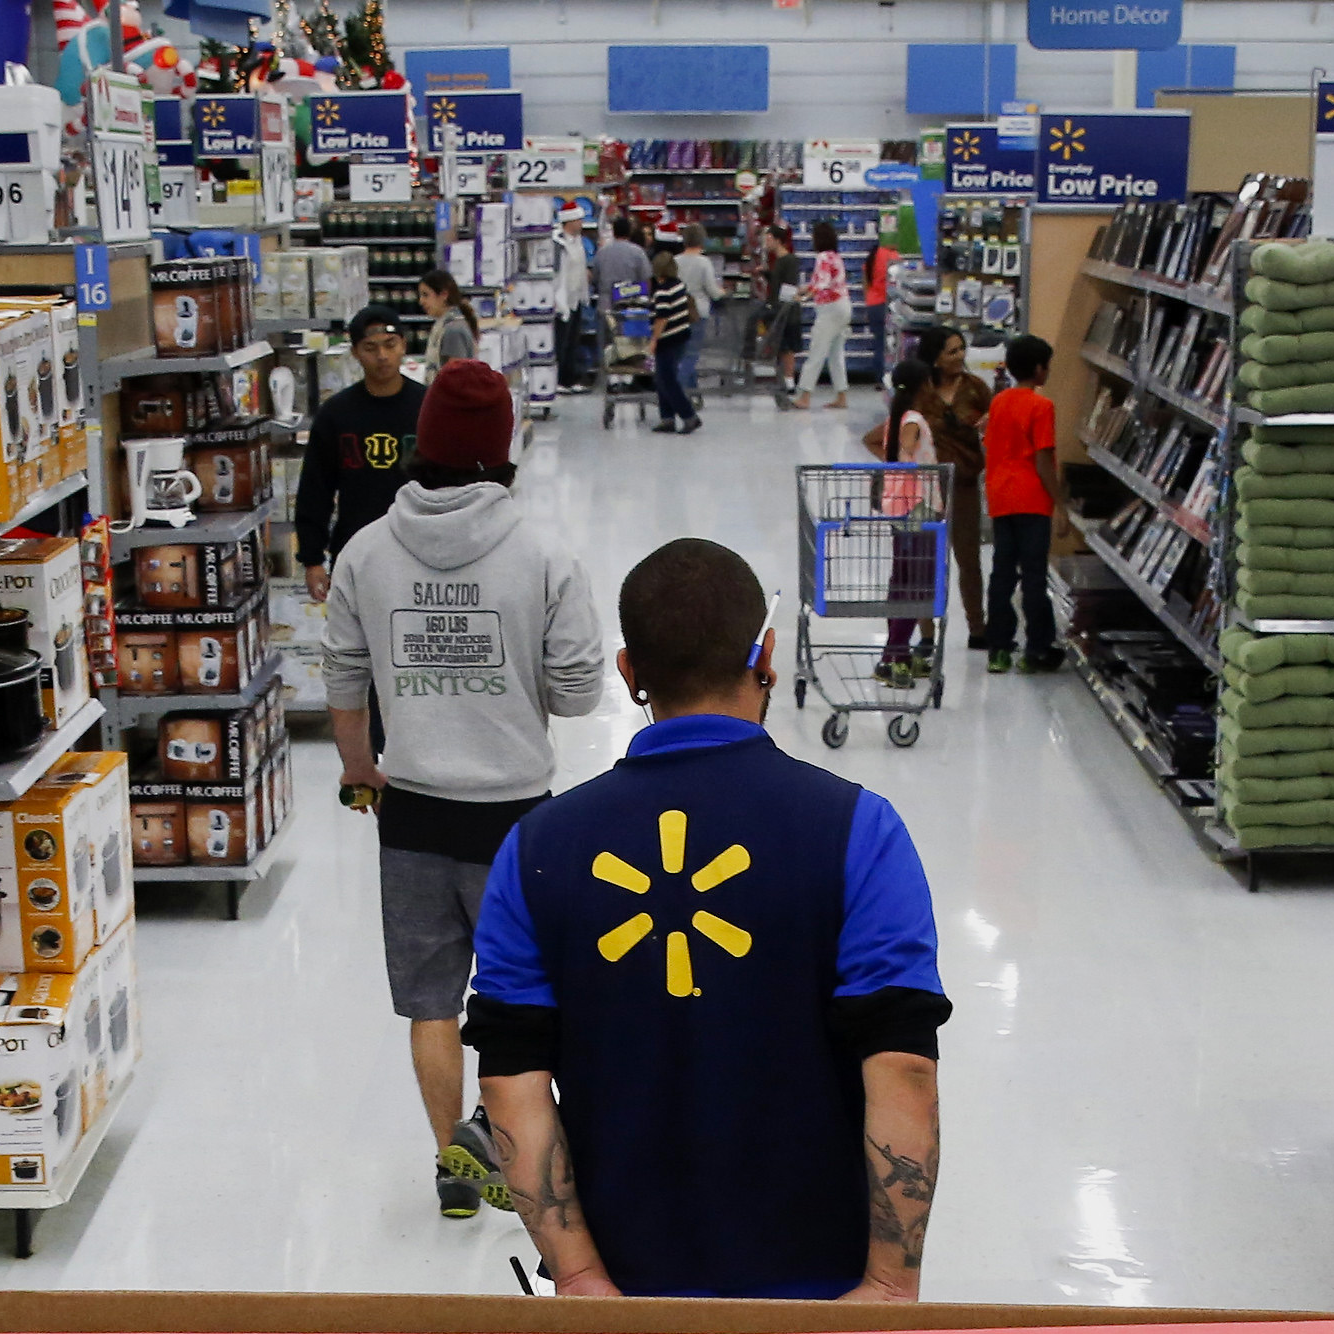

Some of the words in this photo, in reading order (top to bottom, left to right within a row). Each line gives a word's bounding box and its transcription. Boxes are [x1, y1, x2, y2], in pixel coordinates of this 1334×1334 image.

[1051, 6, 1108, 25] Home
[1114, 4, 1169, 25] Décor
[318, 135, 349, 150] Low
[351, 134, 389, 149] Price
[433, 134, 463, 148] Lw
[466, 133, 505, 148] Price
[952, 171, 989, 189] Low
[991, 170, 1034, 189] Price
[1047, 174, 1095, 197] Low
[1099, 174, 1159, 198] Price
[78, 281, 106, 305] 16
[413, 582, 480, 606] SALCIDO
[394, 675, 507, 697] PINTOS
